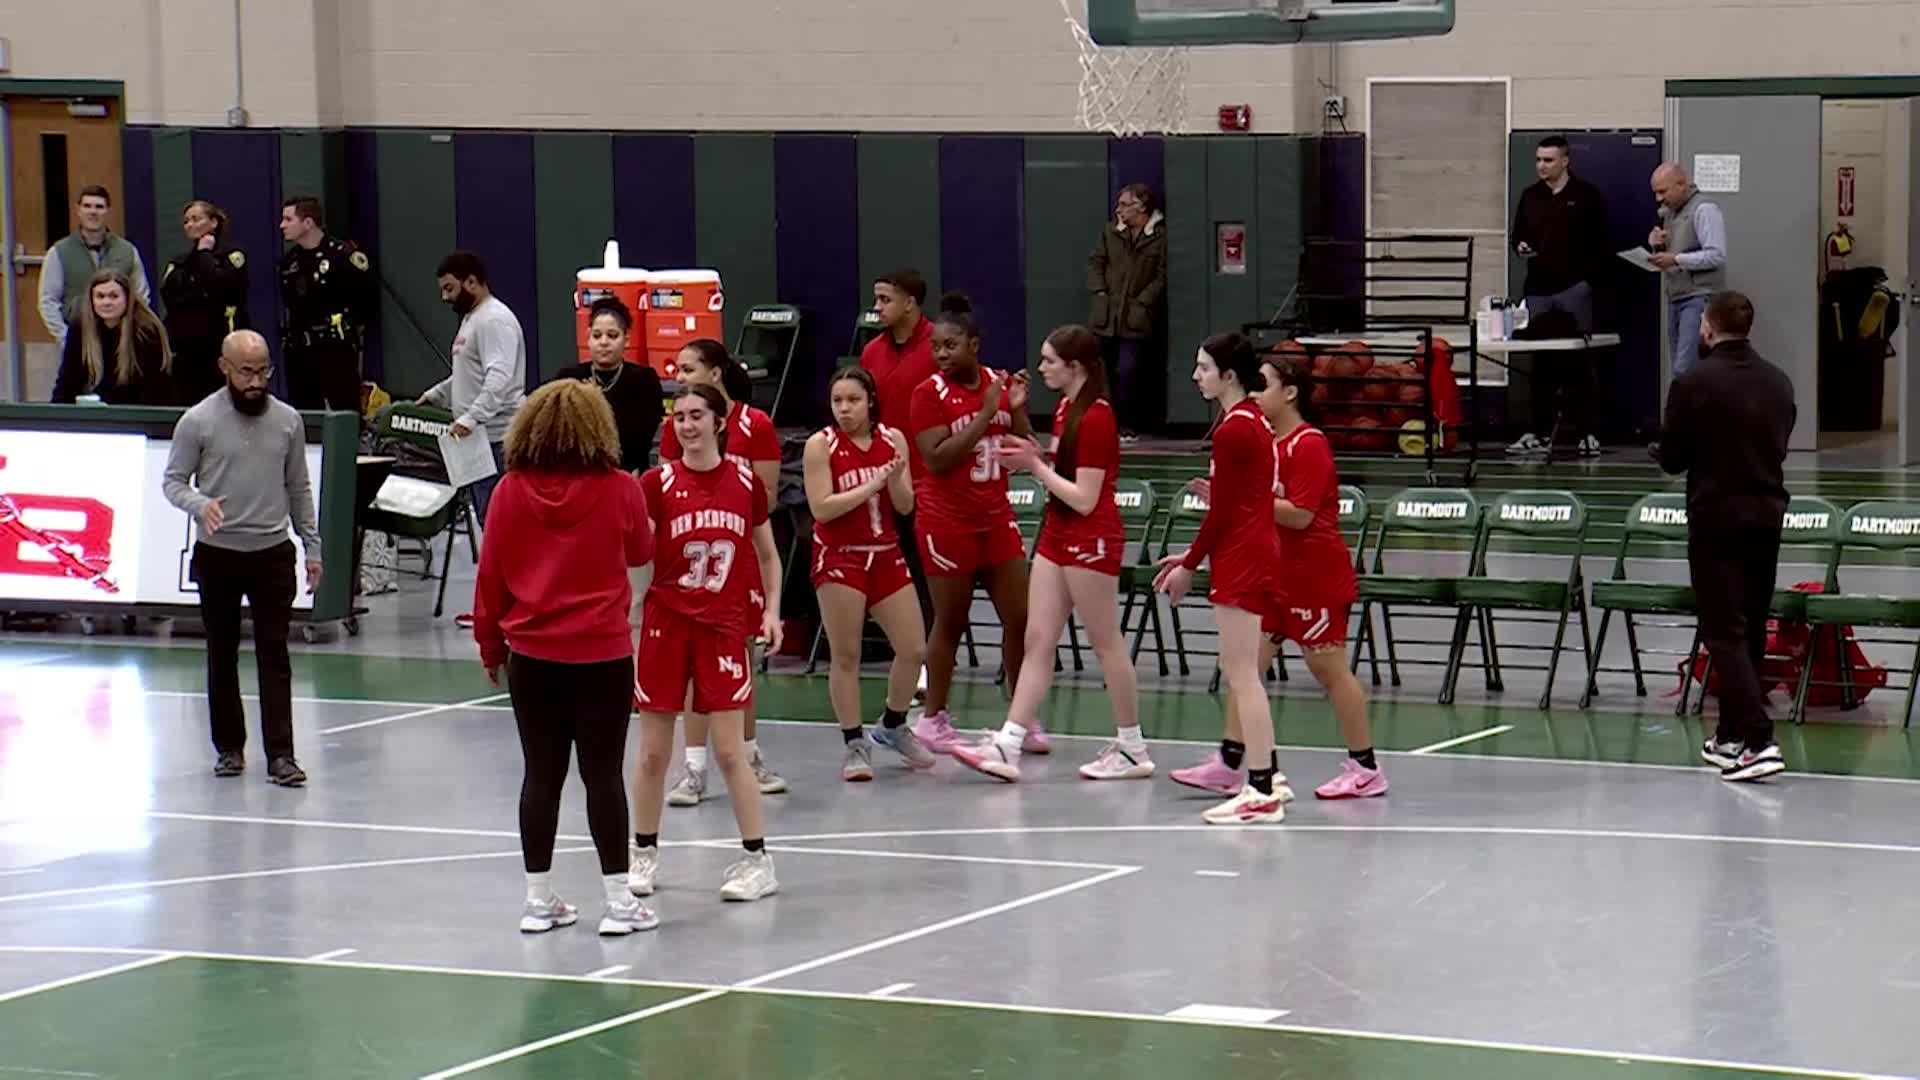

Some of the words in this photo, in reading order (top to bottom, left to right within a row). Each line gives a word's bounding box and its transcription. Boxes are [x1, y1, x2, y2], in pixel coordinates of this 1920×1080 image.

[391, 415, 448, 436] DARTMOUT
[1397, 502, 1467, 518] DARTMOUTH
[1500, 504, 1571, 520] DARTMOUTH
[1639, 508, 1688, 524] DARTM
[670, 512, 692, 540] NEW
[695, 509, 745, 537] BEDFORD
[1782, 513, 1829, 529] TMOUTH
[1852, 516, 1920, 534] DARTMOUT
[678, 539, 736, 593] 33
[718, 655, 743, 679] NB
